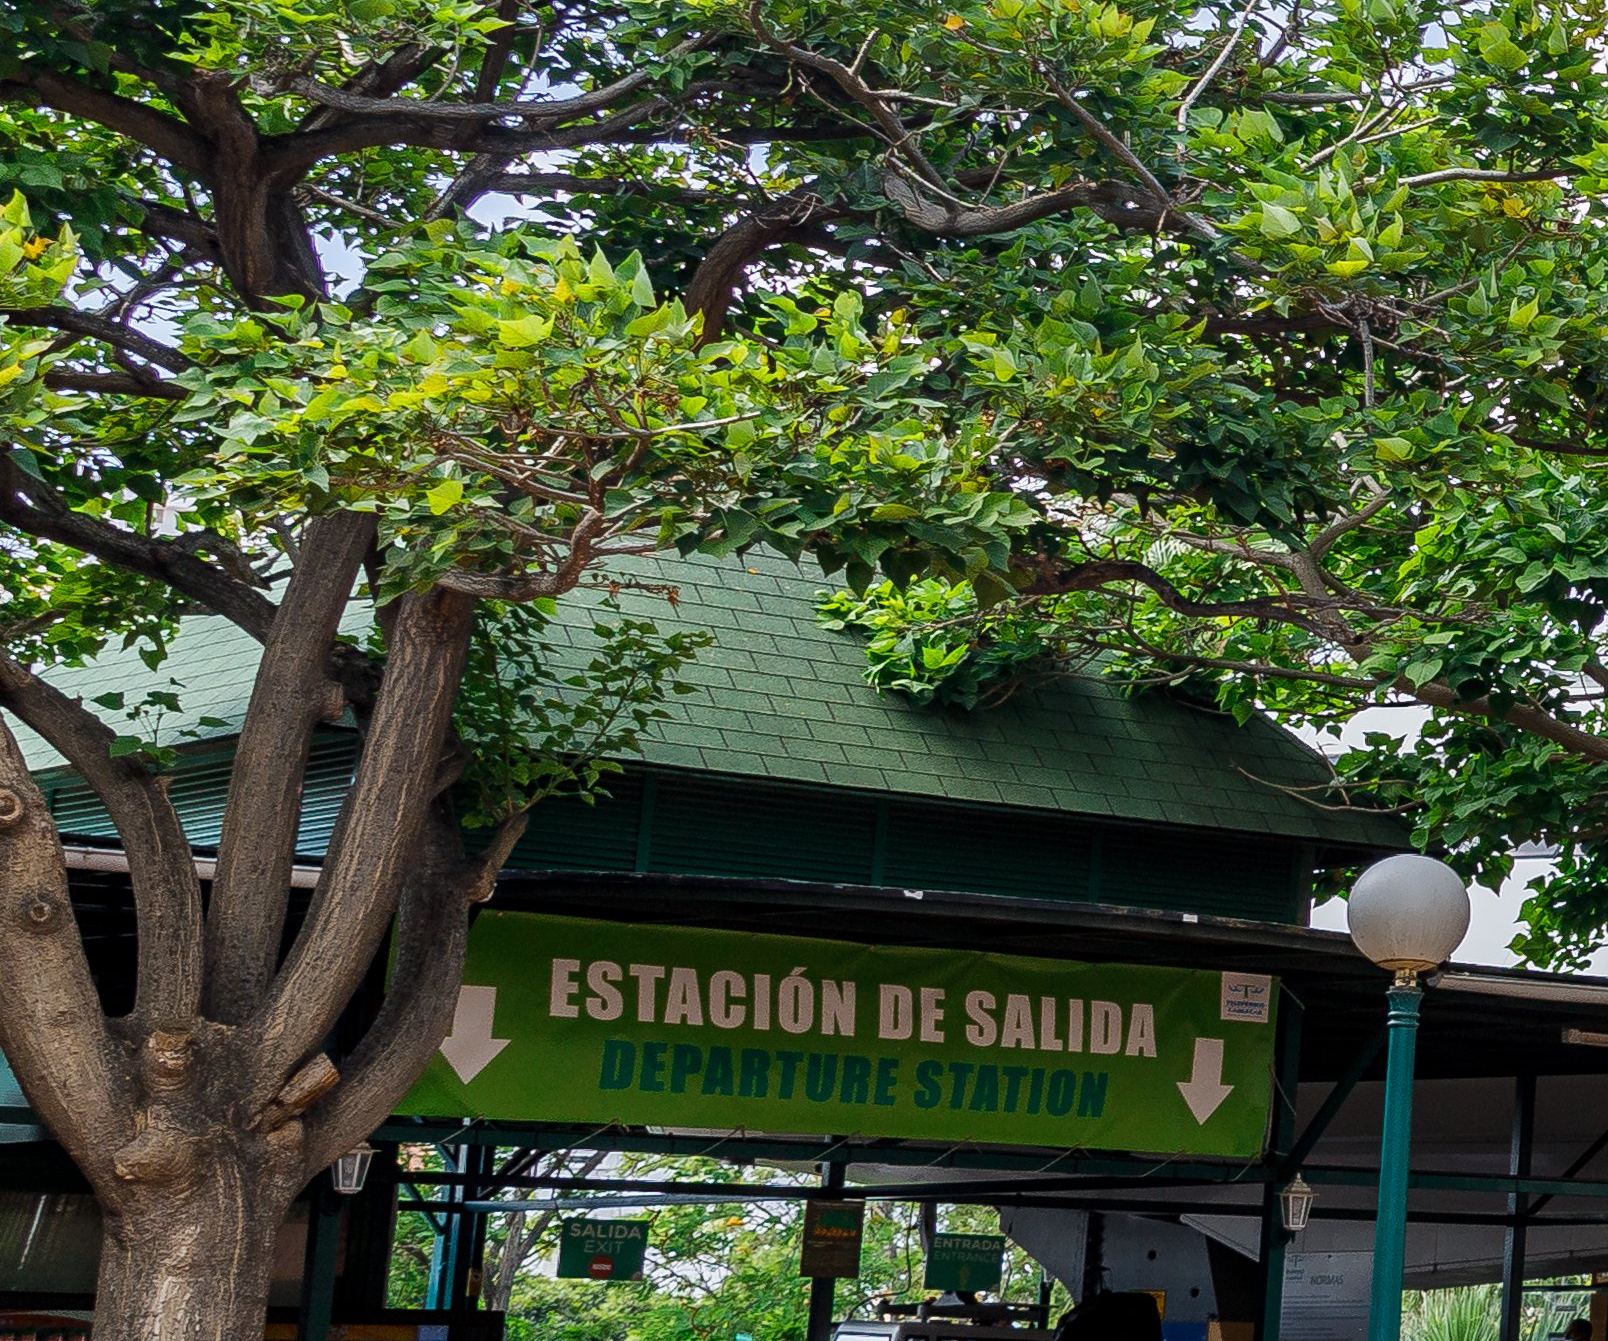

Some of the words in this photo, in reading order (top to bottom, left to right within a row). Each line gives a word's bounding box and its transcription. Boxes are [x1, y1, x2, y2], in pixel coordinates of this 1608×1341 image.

[549, 957, 856, 1037] ESTACIÓN
[878, 983, 946, 1044] DE
[965, 990, 1158, 1058] SALIDA
[599, 1038, 900, 1106] DEPARTURE
[913, 1060, 1109, 1119] STATION
[569, 1223, 642, 1239] SALIDA
[584, 1240, 624, 1253] EXIT
[933, 1237, 1001, 1251] ENTRADA
[933, 1251, 999, 1263] ENTRANCE
[1309, 1274, 1344, 1286] NORMAS
